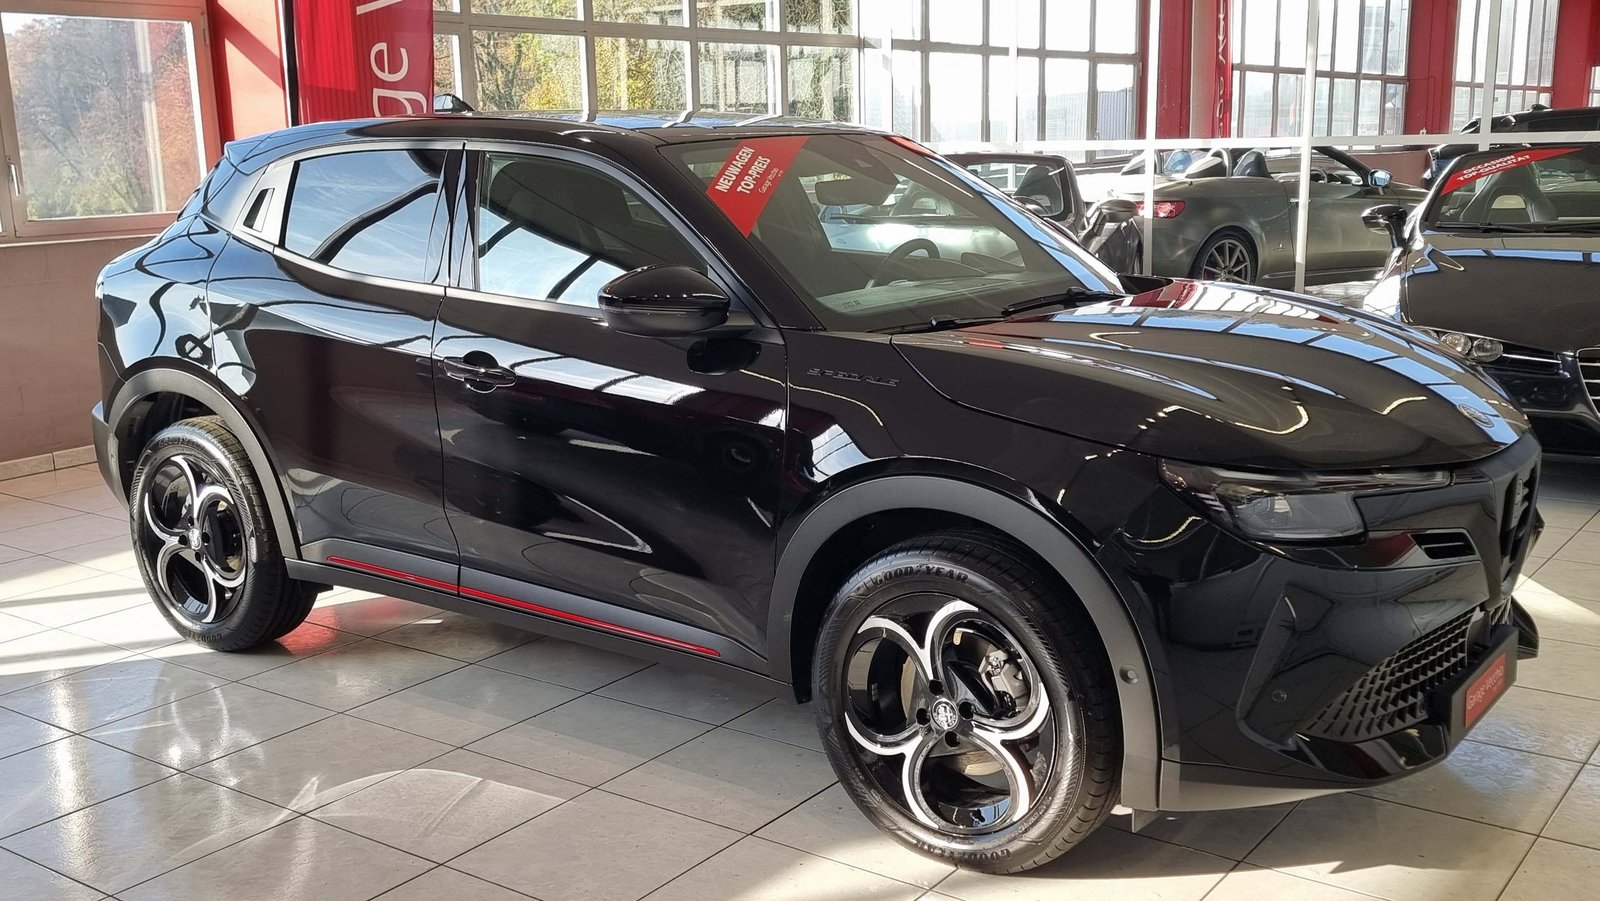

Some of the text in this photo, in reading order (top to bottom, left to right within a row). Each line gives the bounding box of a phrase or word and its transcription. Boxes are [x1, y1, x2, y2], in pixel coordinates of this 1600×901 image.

[714, 146, 755, 192] NEUWAGEN
[737, 155, 771, 194] TOP-PREIS
[1463, 154, 1516, 174] OCCASION
[806, 367, 900, 387] SPECIALE
